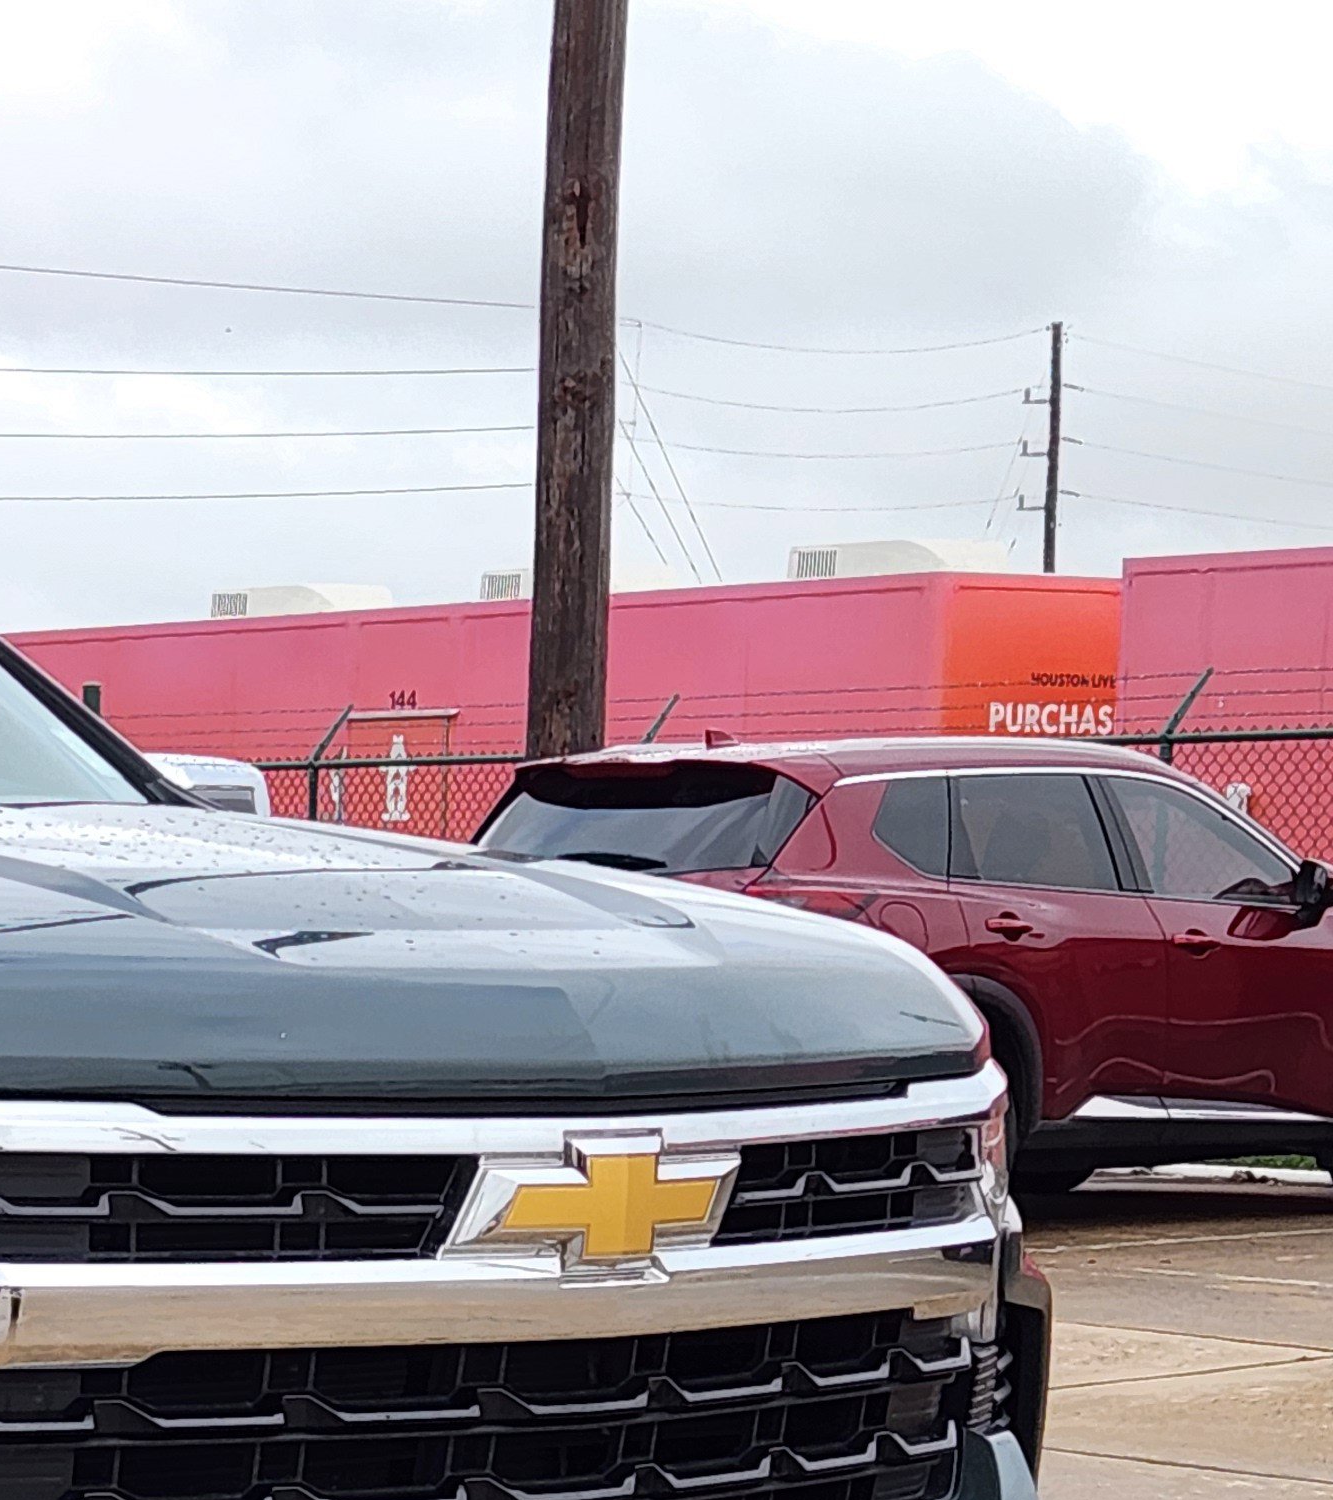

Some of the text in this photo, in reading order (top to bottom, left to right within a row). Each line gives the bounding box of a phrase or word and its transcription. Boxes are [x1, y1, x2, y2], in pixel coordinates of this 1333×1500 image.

[1030, 671, 1116, 689] HOUSTON LIVE
[388, 689, 418, 709] 144
[988, 700, 1113, 735] PURCHAS
